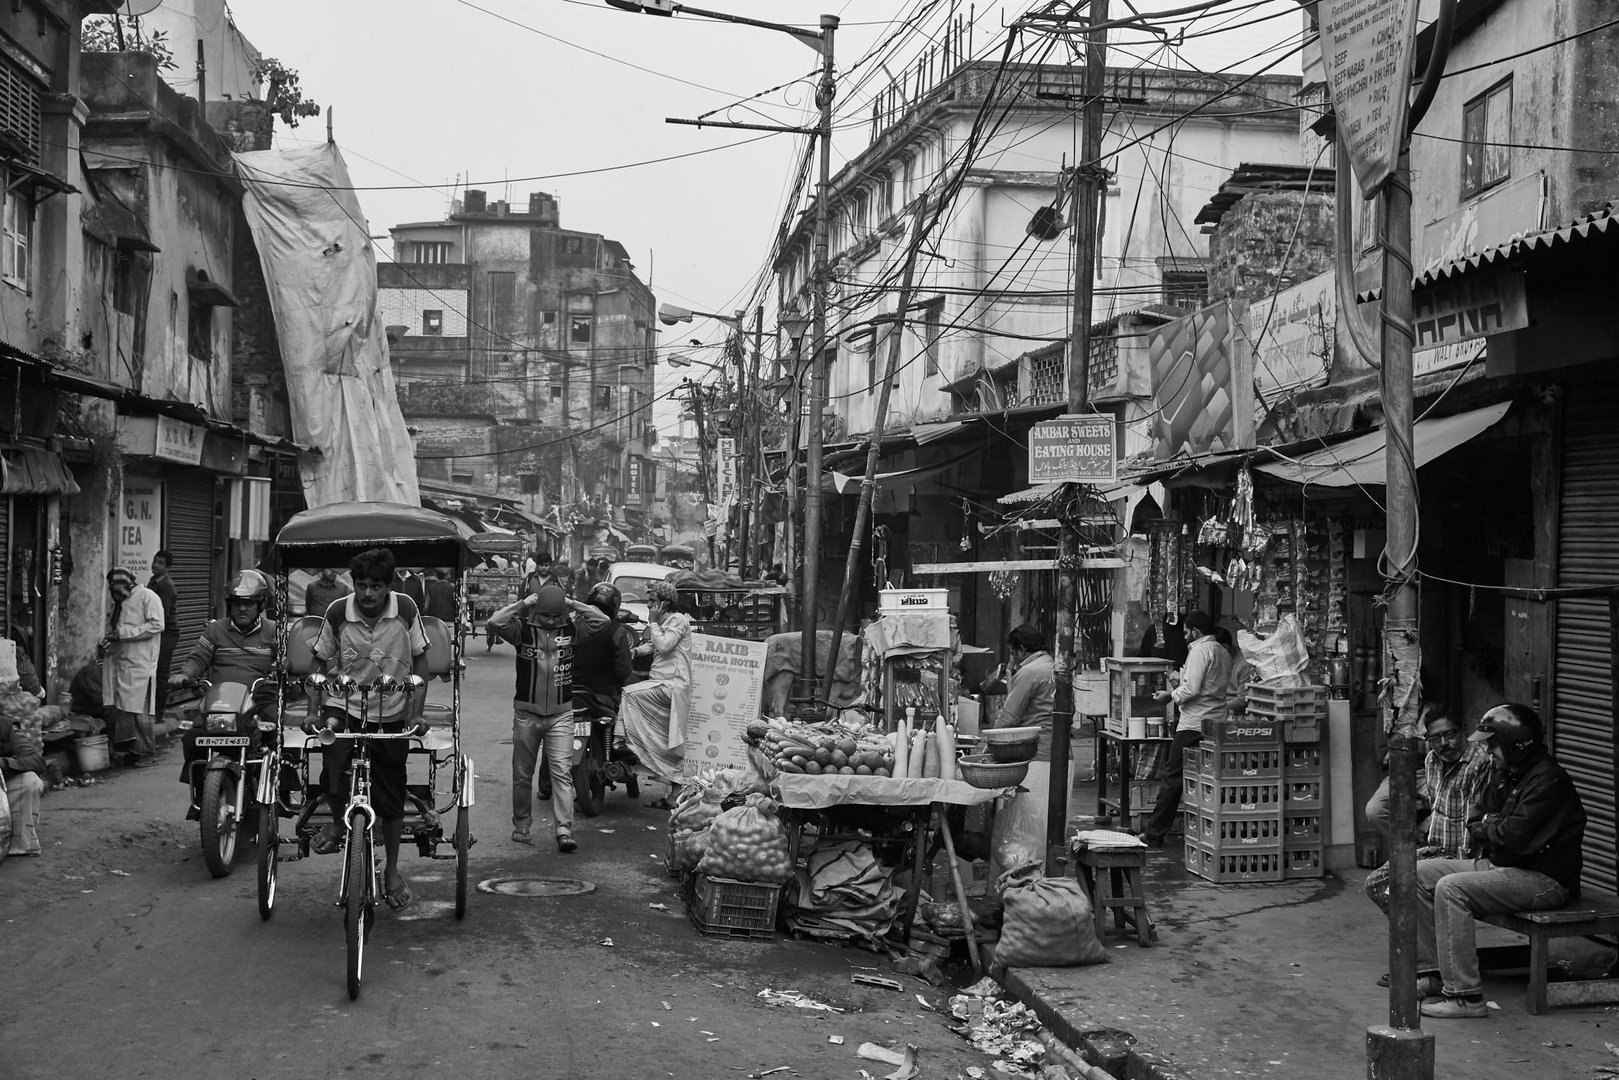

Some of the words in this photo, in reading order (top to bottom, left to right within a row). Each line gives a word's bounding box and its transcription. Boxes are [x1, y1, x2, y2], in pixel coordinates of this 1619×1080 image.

[1334, 49, 1348, 69] BEEF
[1334, 69, 1347, 88] BEEF
[1034, 426, 1070, 439] AMBAR
[1071, 424, 1111, 438] SWEETS
[1034, 445, 1074, 458] EATING
[1076, 443, 1111, 457] HOUSE
[630, 463, 638, 494] HOTEL
[126, 499, 138, 520] G.
[140, 499, 152, 520] N.
[122, 525, 143, 546] TEA
[705, 640, 749, 657] RAKIB
[730, 657, 761, 669] HOTEL
[1236, 727, 1273, 736] PEPSI
